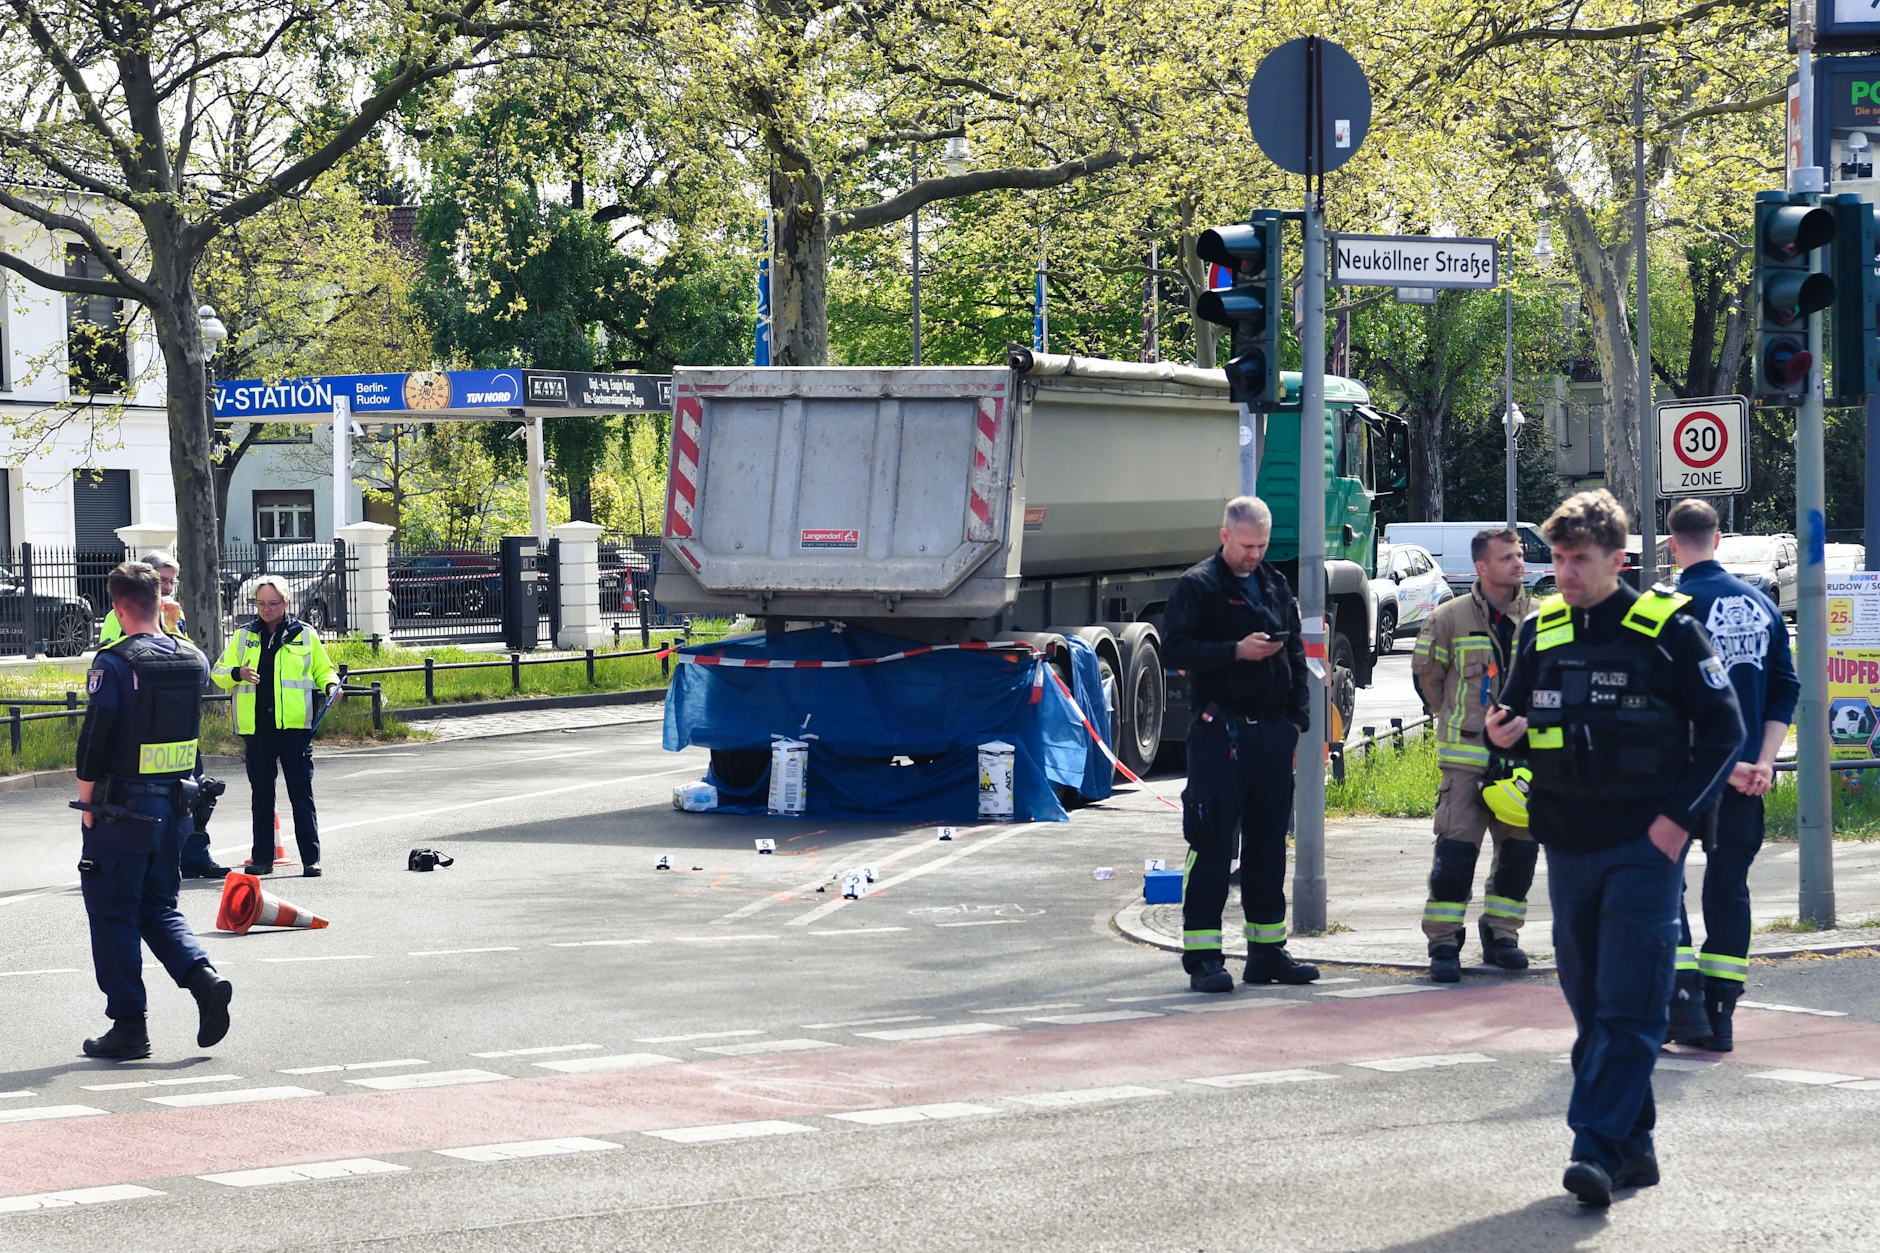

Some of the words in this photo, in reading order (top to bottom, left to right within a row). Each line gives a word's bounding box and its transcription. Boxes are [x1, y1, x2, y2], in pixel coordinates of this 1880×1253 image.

[1855, 106, 1870, 115] Die
[1338, 247, 1429, 271] Neuköllner
[1435, 250, 1490, 278] Straße
[356, 382, 388, 394] Berlin-
[533, 380, 563, 397] KAYA
[623, 379, 636, 393] Kaya
[422, 387, 432, 397] HU
[485, 391, 511, 403] NORD
[356, 394, 391, 405] Rudow
[1685, 426, 1717, 453] 30
[1681, 471, 1723, 487] ZONE
[803, 532, 842, 541] Langendorf
[526, 583, 533, 597] 5
[1827, 583, 1862, 591] RUDOW
[1830, 611, 1852, 624] 25.
[1591, 671, 1628, 687] POLIZEI
[943, 827, 951, 837] 6
[761, 839, 770, 849] 5
[659, 855, 668, 865] 4
[863, 868, 872, 878] 3
[848, 884, 855, 895] 1
